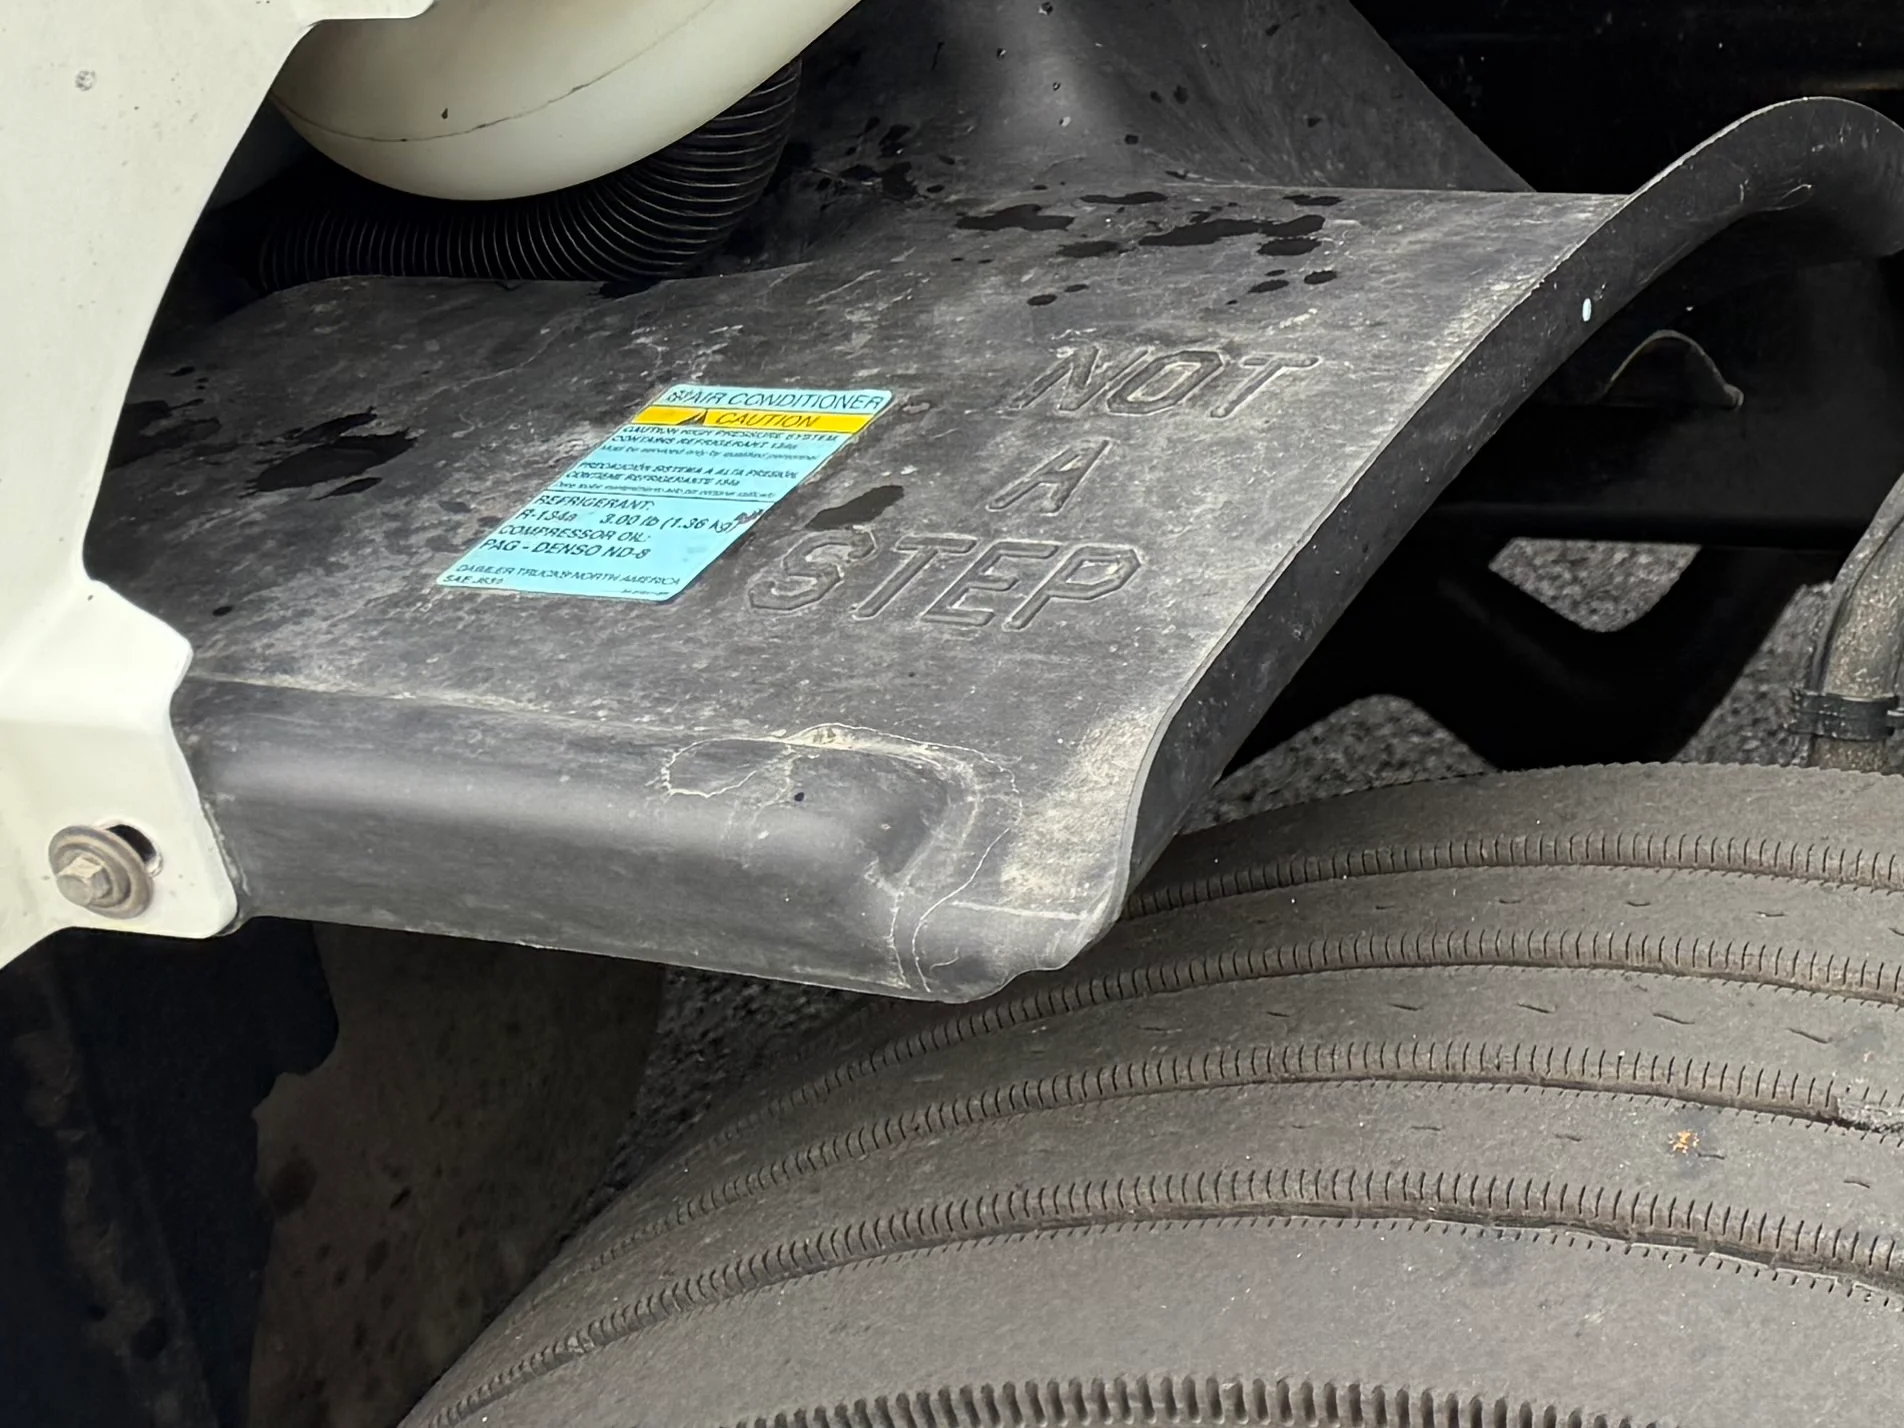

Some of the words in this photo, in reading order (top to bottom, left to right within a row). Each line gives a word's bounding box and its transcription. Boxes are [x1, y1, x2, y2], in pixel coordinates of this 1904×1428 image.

[1008, 346, 1323, 419] NOT
[684, 390, 731, 404] AIR
[723, 390, 887, 411] CONDITIONER
[712, 412, 821, 428] CAUTION
[609, 435, 676, 444] CONTAINS
[675, 437, 768, 448] REFRIGERANT
[712, 429, 784, 439] PRESSURE
[783, 433, 840, 442] SYSTEM
[985, 438, 1112, 515] A
[533, 493, 657, 511] REFRIGERANT:
[514, 508, 582, 522] R-134a
[596, 513, 643, 525] 3.00
[637, 515, 664, 527] lb
[496, 522, 618, 542] COMPRESSOR
[478, 537, 524, 551] PAG
[529, 540, 606, 557] DENSO
[600, 544, 654, 559] ND-8
[749, 527, 1144, 632] STEP
